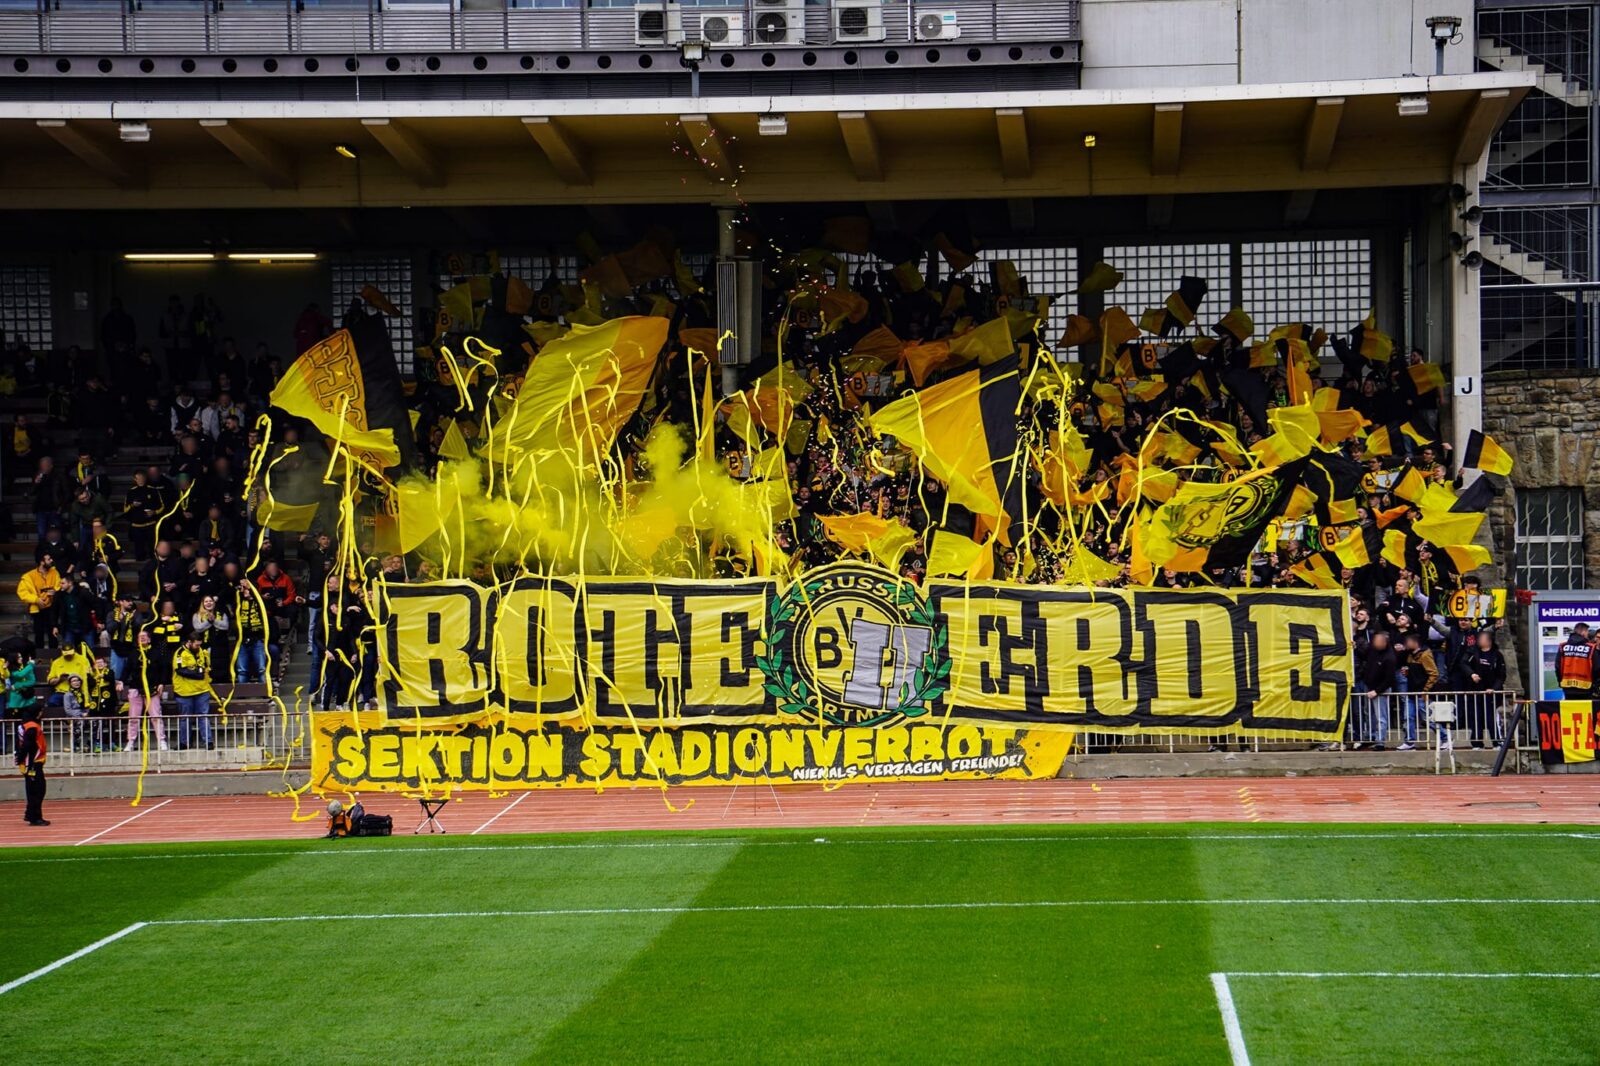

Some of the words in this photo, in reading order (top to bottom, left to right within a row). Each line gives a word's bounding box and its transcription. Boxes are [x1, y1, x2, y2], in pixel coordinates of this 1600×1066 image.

[1144, 348, 1153, 362] B
[854, 377, 863, 391] B
[1461, 376, 1473, 395] J
[729, 456, 738, 470] B
[1326, 532, 1335, 545] B
[1456, 597, 1465, 611] B
[1541, 608, 1599, 617] WERHAND
[388, 581, 772, 717] ROTE
[934, 587, 1345, 728] ERDE
[336, 733, 563, 780] SEKTION
[580, 725, 1016, 778] STADIONVERBOT
[793, 765, 858, 780] NIEMALS
[865, 761, 943, 776] VERZAGEN
[951, 754, 1024, 771] FREUNDE!
